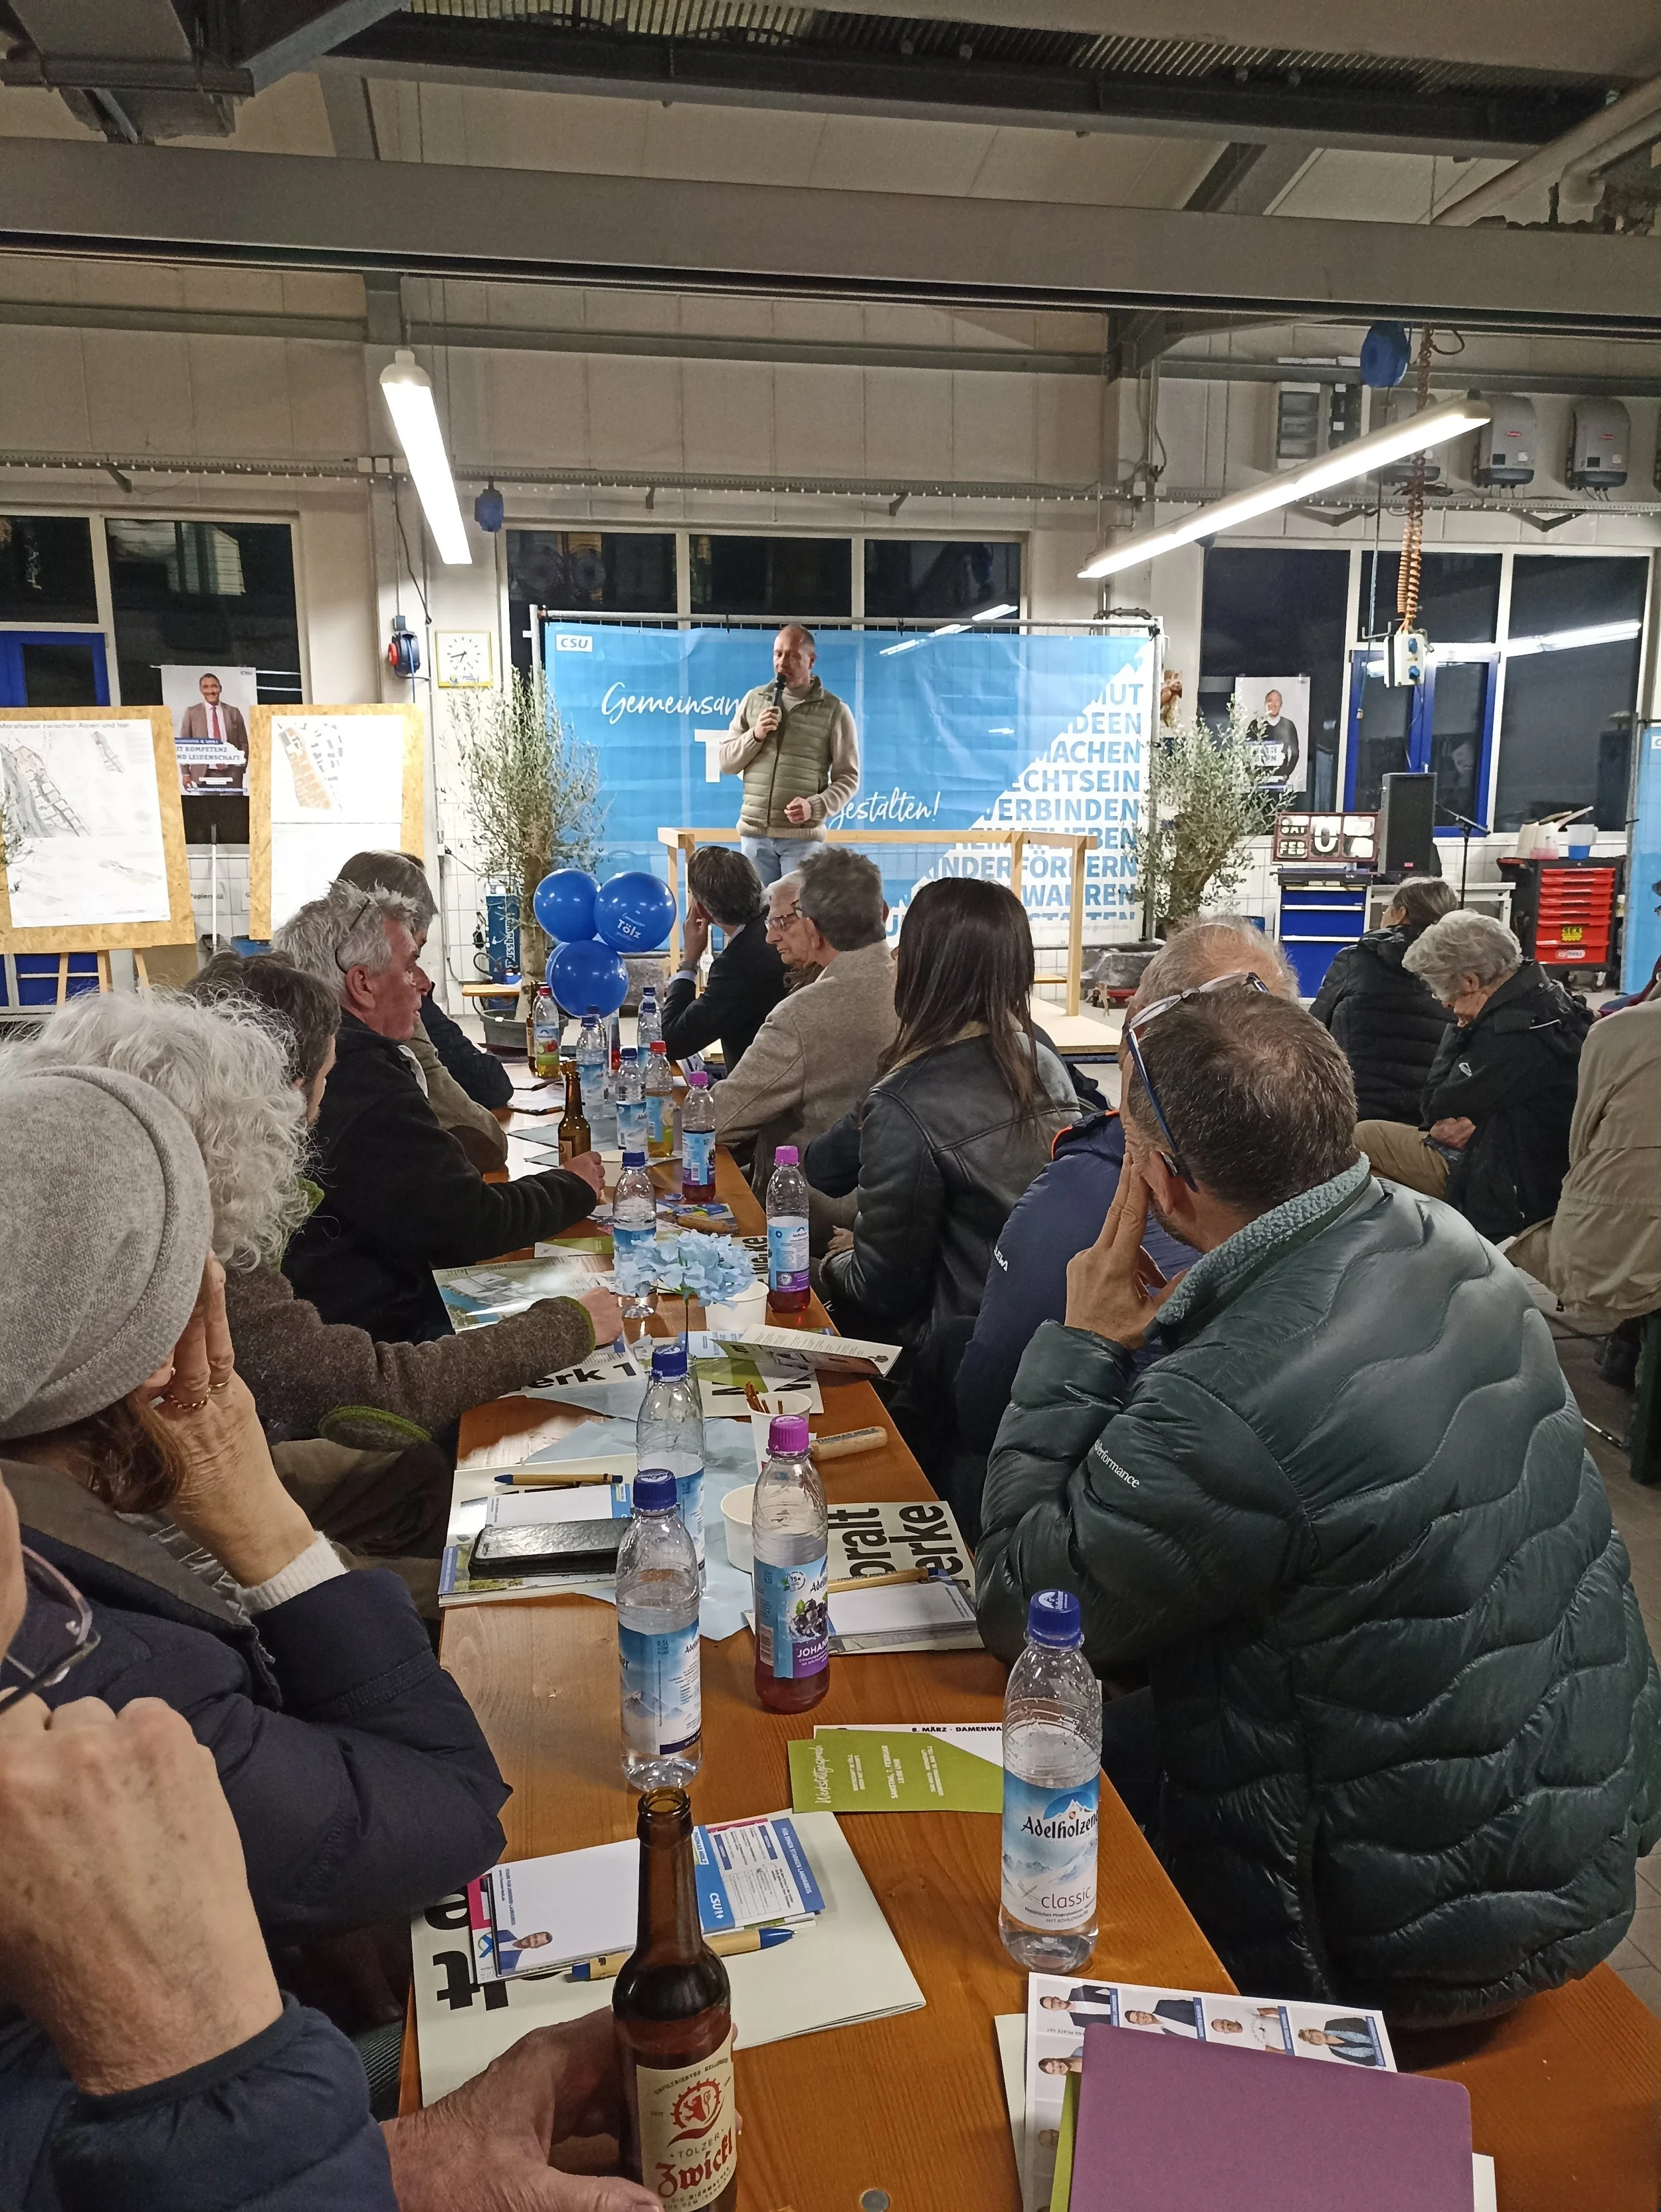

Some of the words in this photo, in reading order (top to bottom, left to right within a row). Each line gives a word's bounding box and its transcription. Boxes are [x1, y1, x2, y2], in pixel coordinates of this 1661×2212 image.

[561, 638, 588, 649] CSU
[617, 919, 642, 939] Tölz
[528, 1368, 606, 1389] erk
[827, 1508, 898, 1579] oralt
[708, 1892, 724, 1910] CSU
[1041, 1886, 1092, 1909] classic
